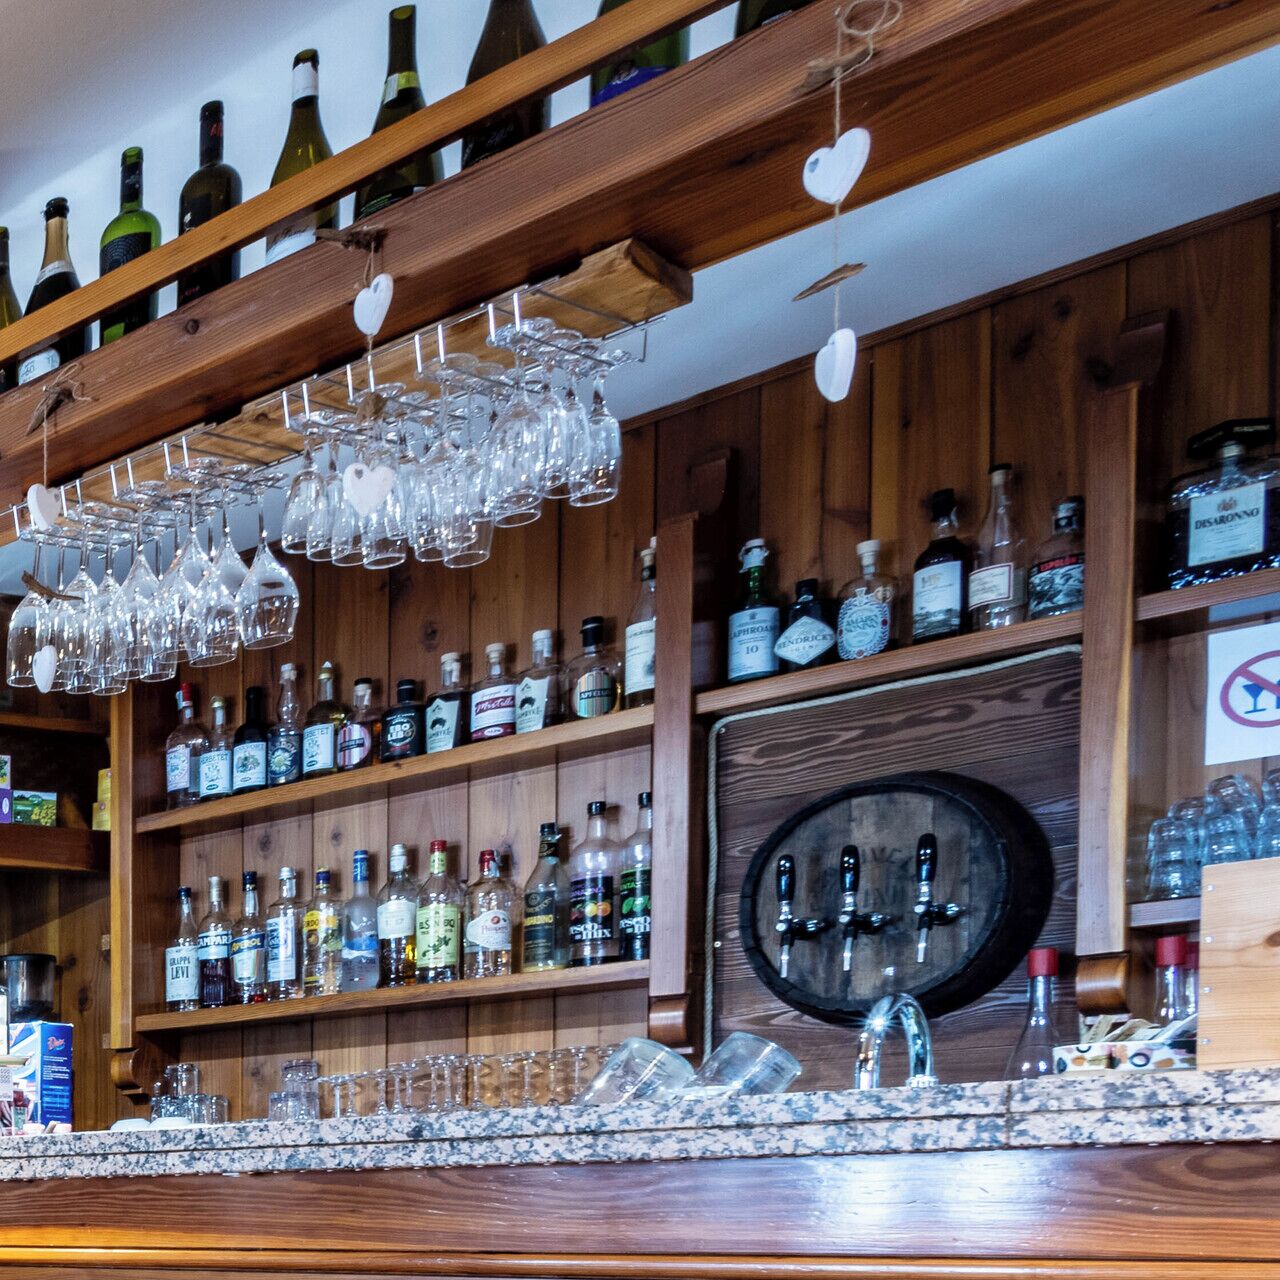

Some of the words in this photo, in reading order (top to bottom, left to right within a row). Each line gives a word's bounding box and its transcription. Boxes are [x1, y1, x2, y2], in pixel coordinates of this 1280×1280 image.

[1194, 507, 1260, 530] DISARONNO
[745, 645, 759, 655] 10
[231, 938, 262, 953] APEROL
[169, 955, 191, 967] GRAPPA
[171, 966, 189, 980] LEVI
